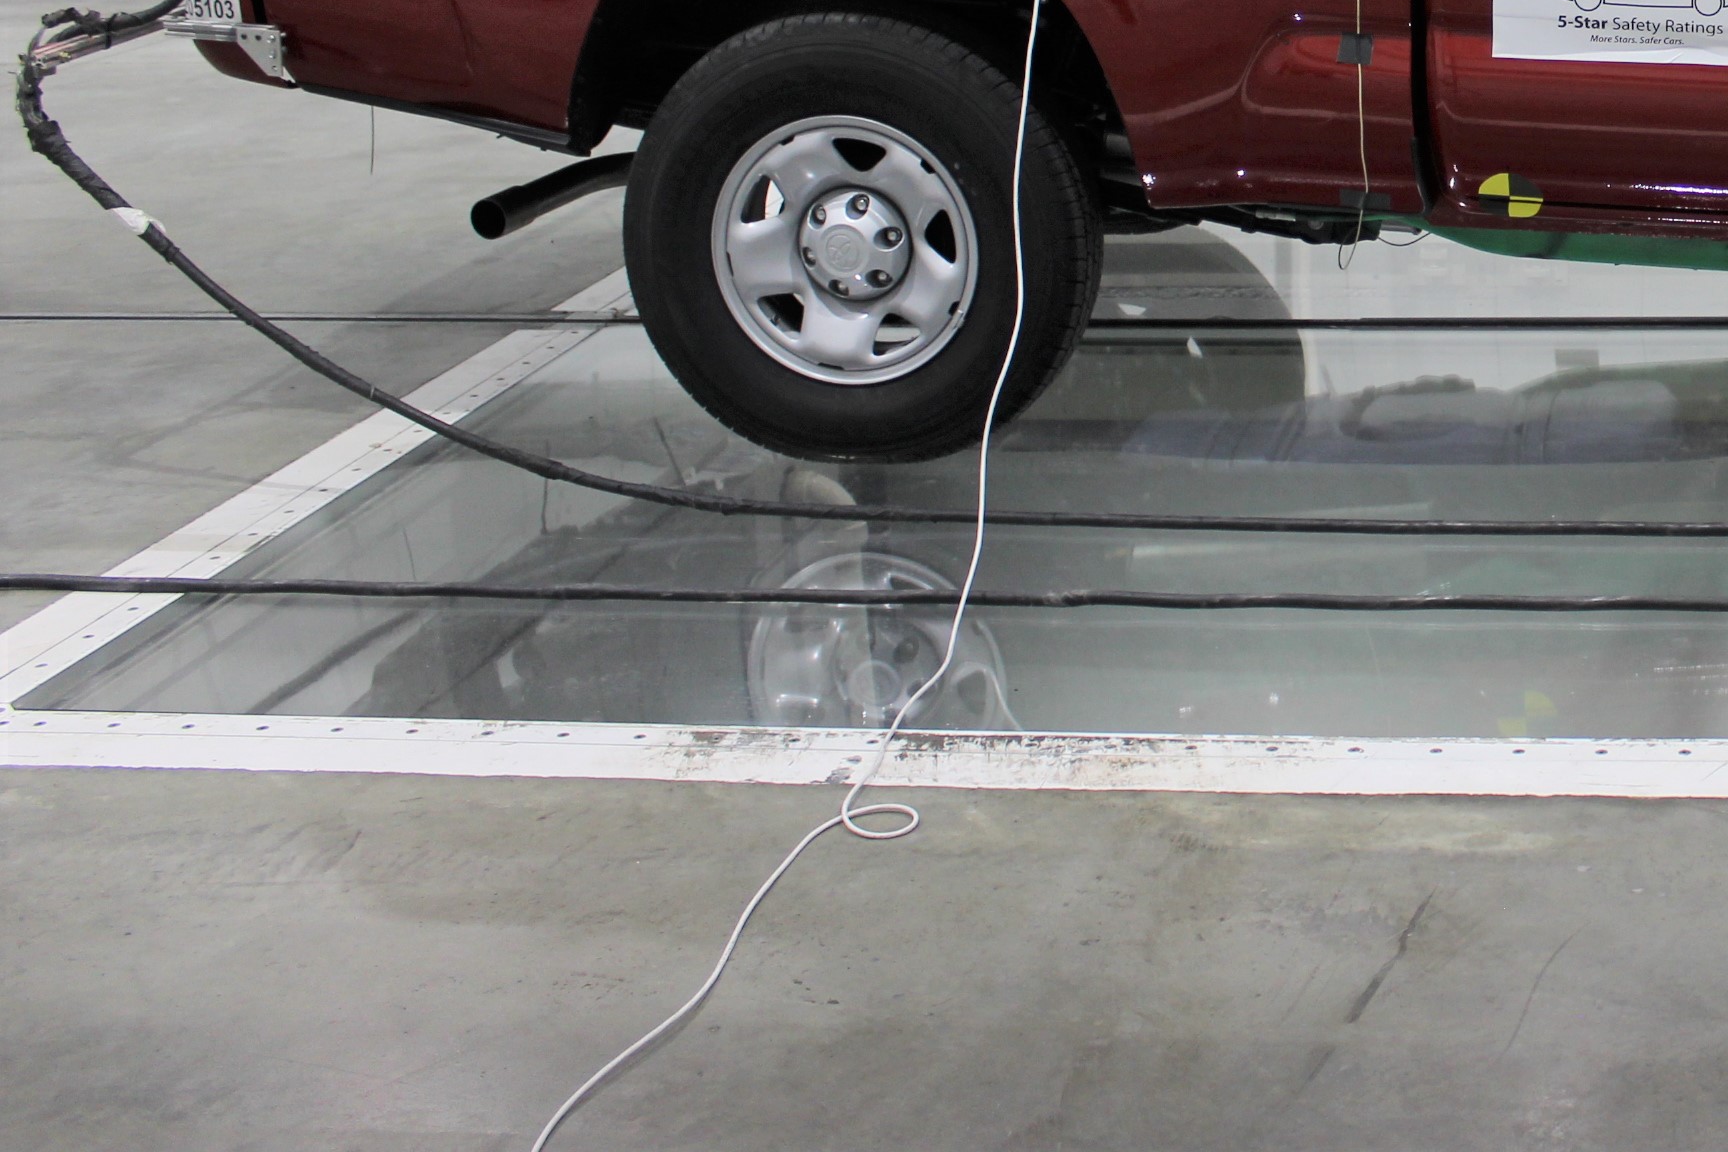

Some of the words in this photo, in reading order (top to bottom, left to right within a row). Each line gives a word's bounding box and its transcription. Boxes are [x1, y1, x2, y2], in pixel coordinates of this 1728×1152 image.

[1557, 15, 1609, 29] 5-Star
[1612, 17, 1661, 35] Safety
[1664, 19, 1724, 37] Ratings
[1590, 34, 1612, 43] More
[1614, 35, 1638, 44] Stars.
[1639, 36, 1662, 45] Safer
[1663, 37, 1685, 45] Cars.
